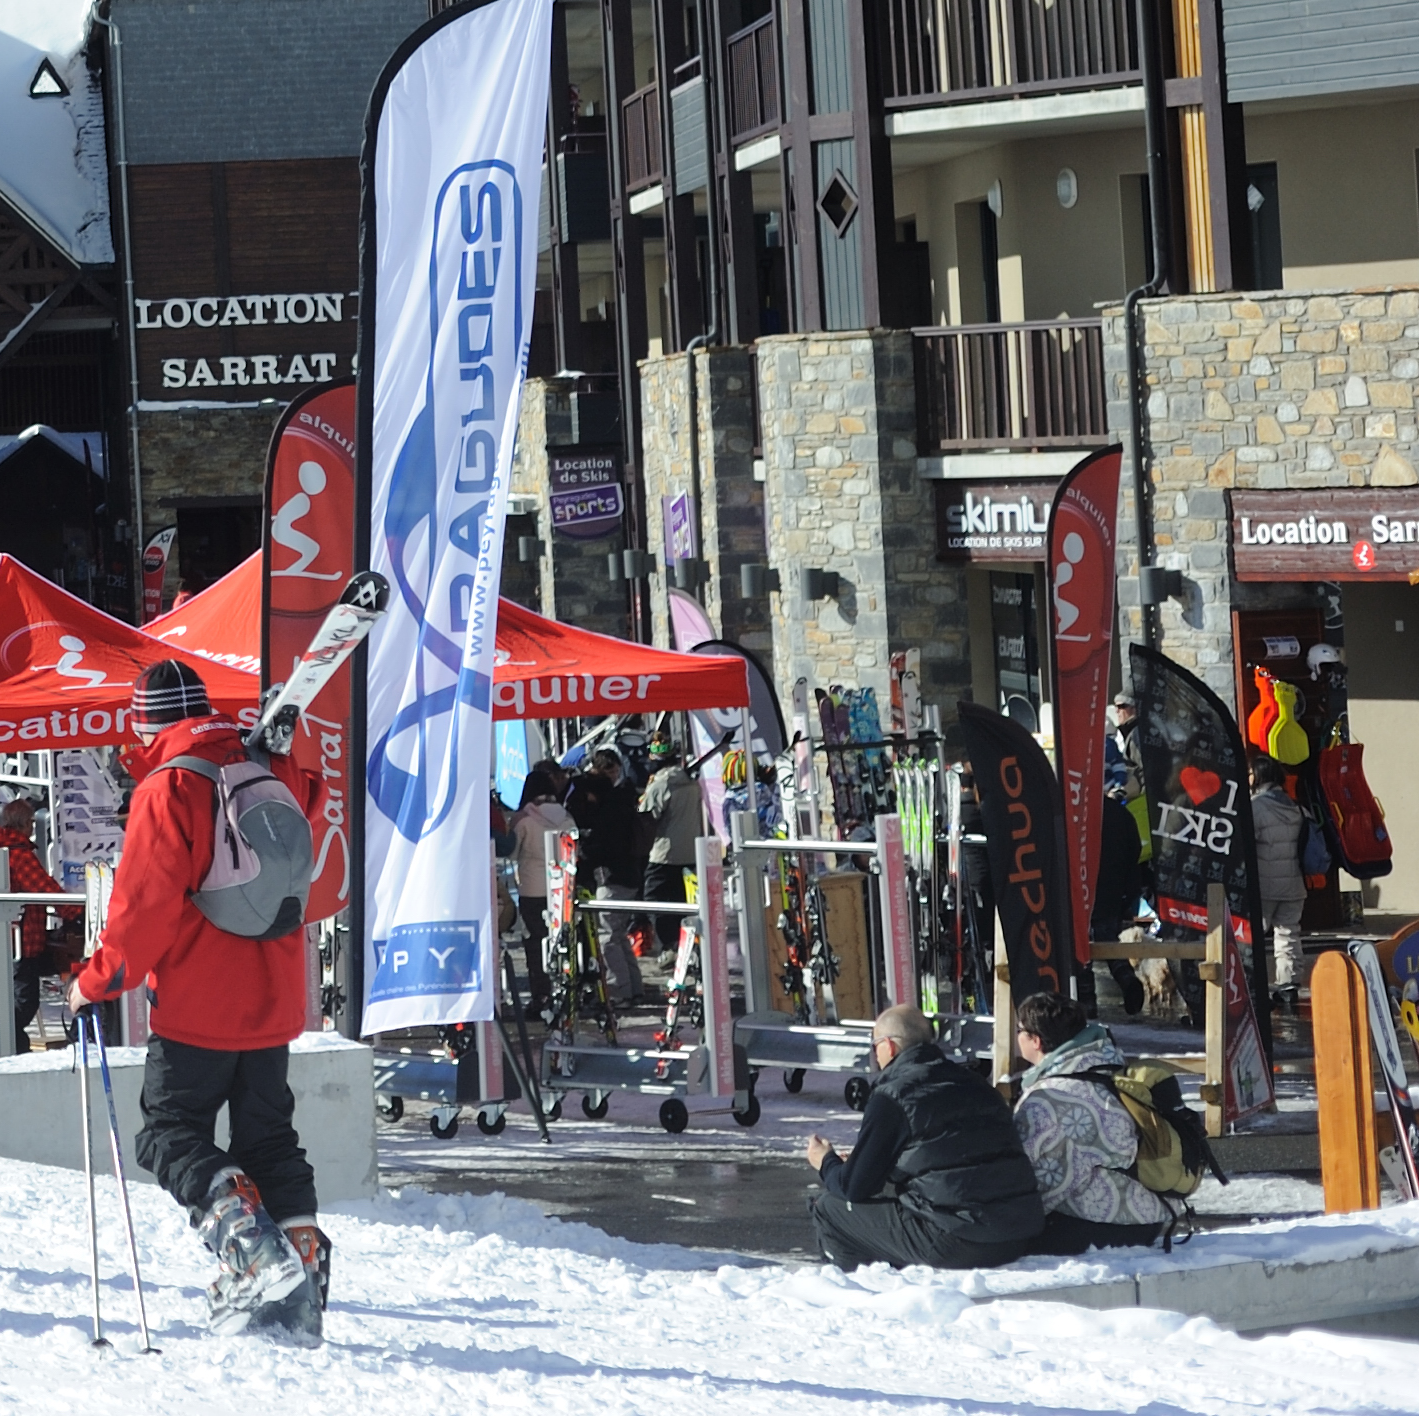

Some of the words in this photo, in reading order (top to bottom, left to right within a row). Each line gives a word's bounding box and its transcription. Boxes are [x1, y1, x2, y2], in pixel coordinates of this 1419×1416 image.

[136, 294, 344, 328] LOCATION
[163, 353, 336, 388] SARRAT
[555, 457, 612, 471] Location
[560, 472, 578, 483] de
[581, 470, 610, 483] Skis
[555, 497, 616, 521] sports
[1241, 516, 1349, 544] Location
